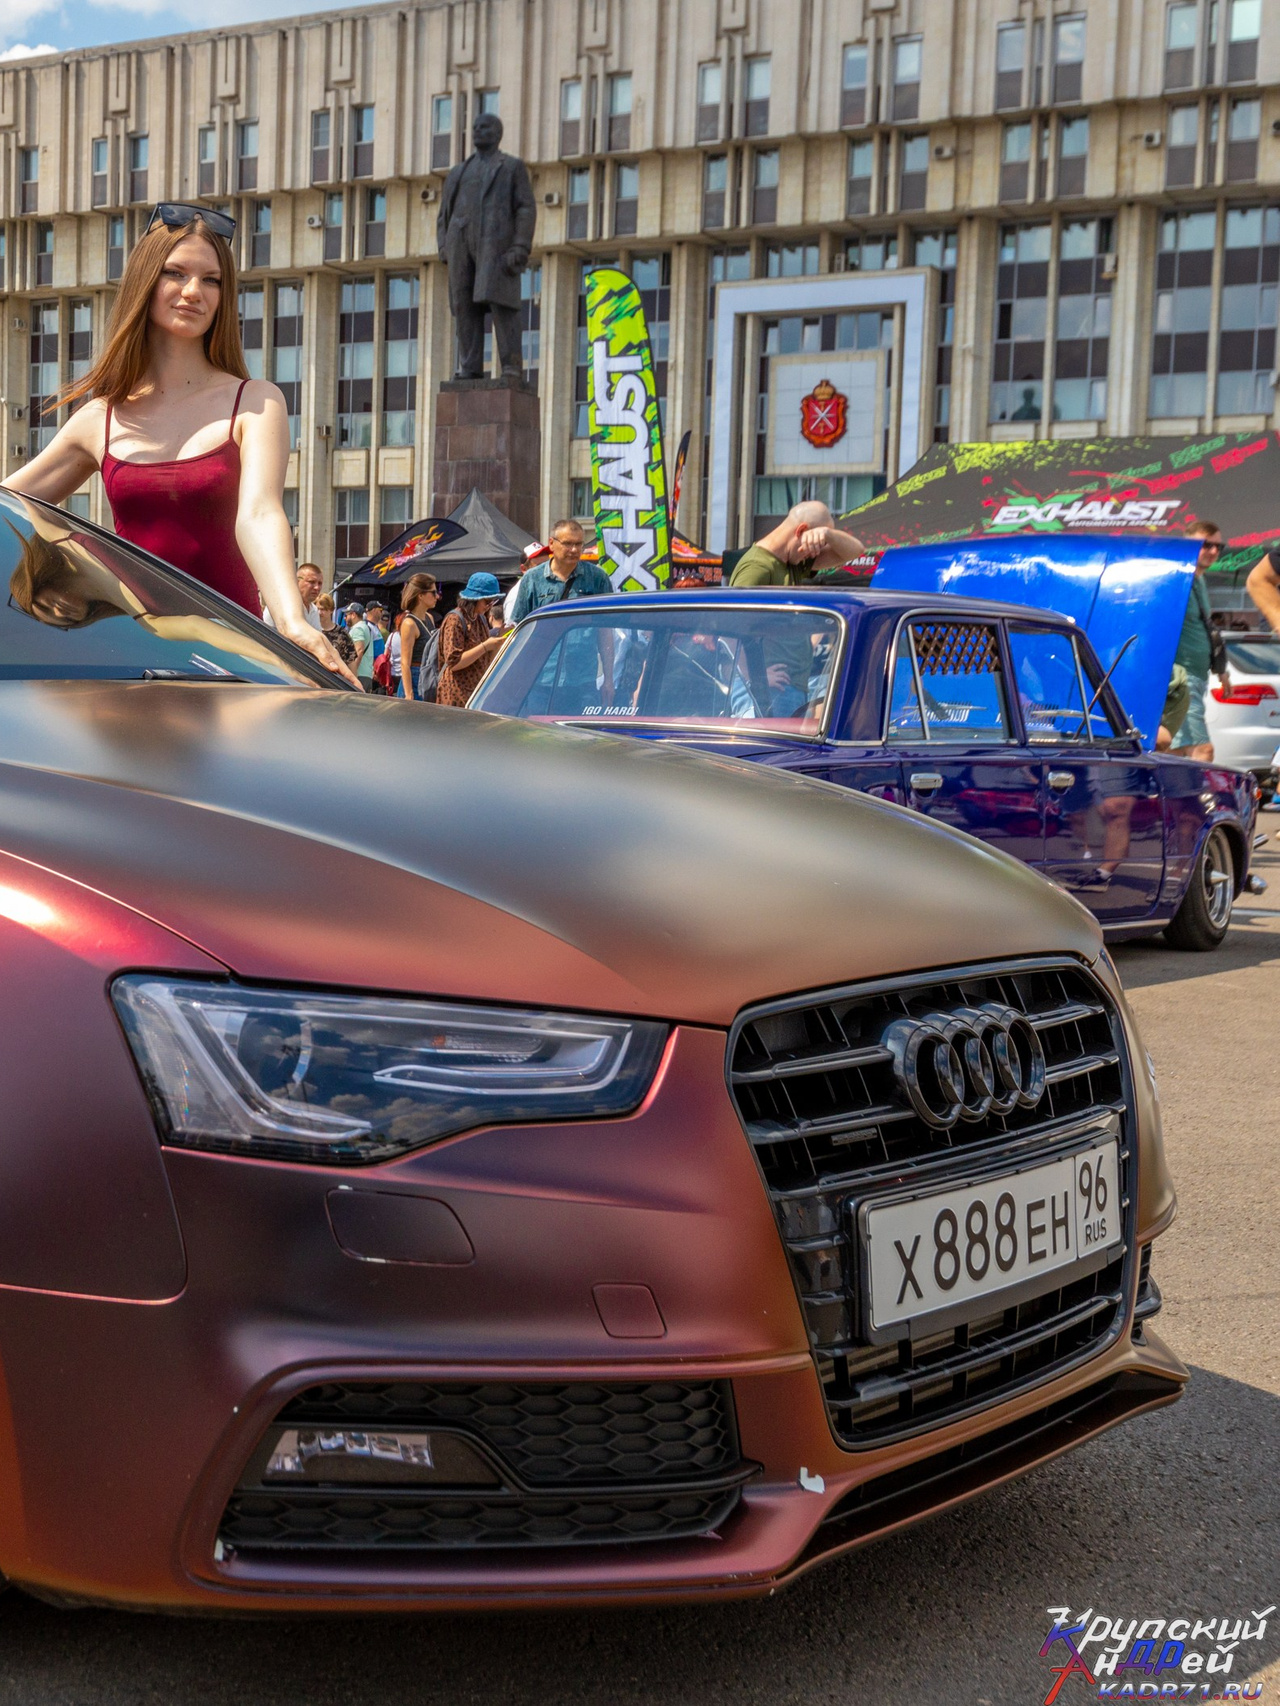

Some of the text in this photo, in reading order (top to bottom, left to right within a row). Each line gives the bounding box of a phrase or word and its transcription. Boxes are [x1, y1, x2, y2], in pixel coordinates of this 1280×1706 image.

[989, 497, 1181, 529] EXHAUST
[1067, 518, 1128, 528] AUTOMOTIVE
[603, 706, 640, 716] HARD!
[1079, 1154, 1108, 1220] 96
[1084, 1218, 1108, 1247] RUS
